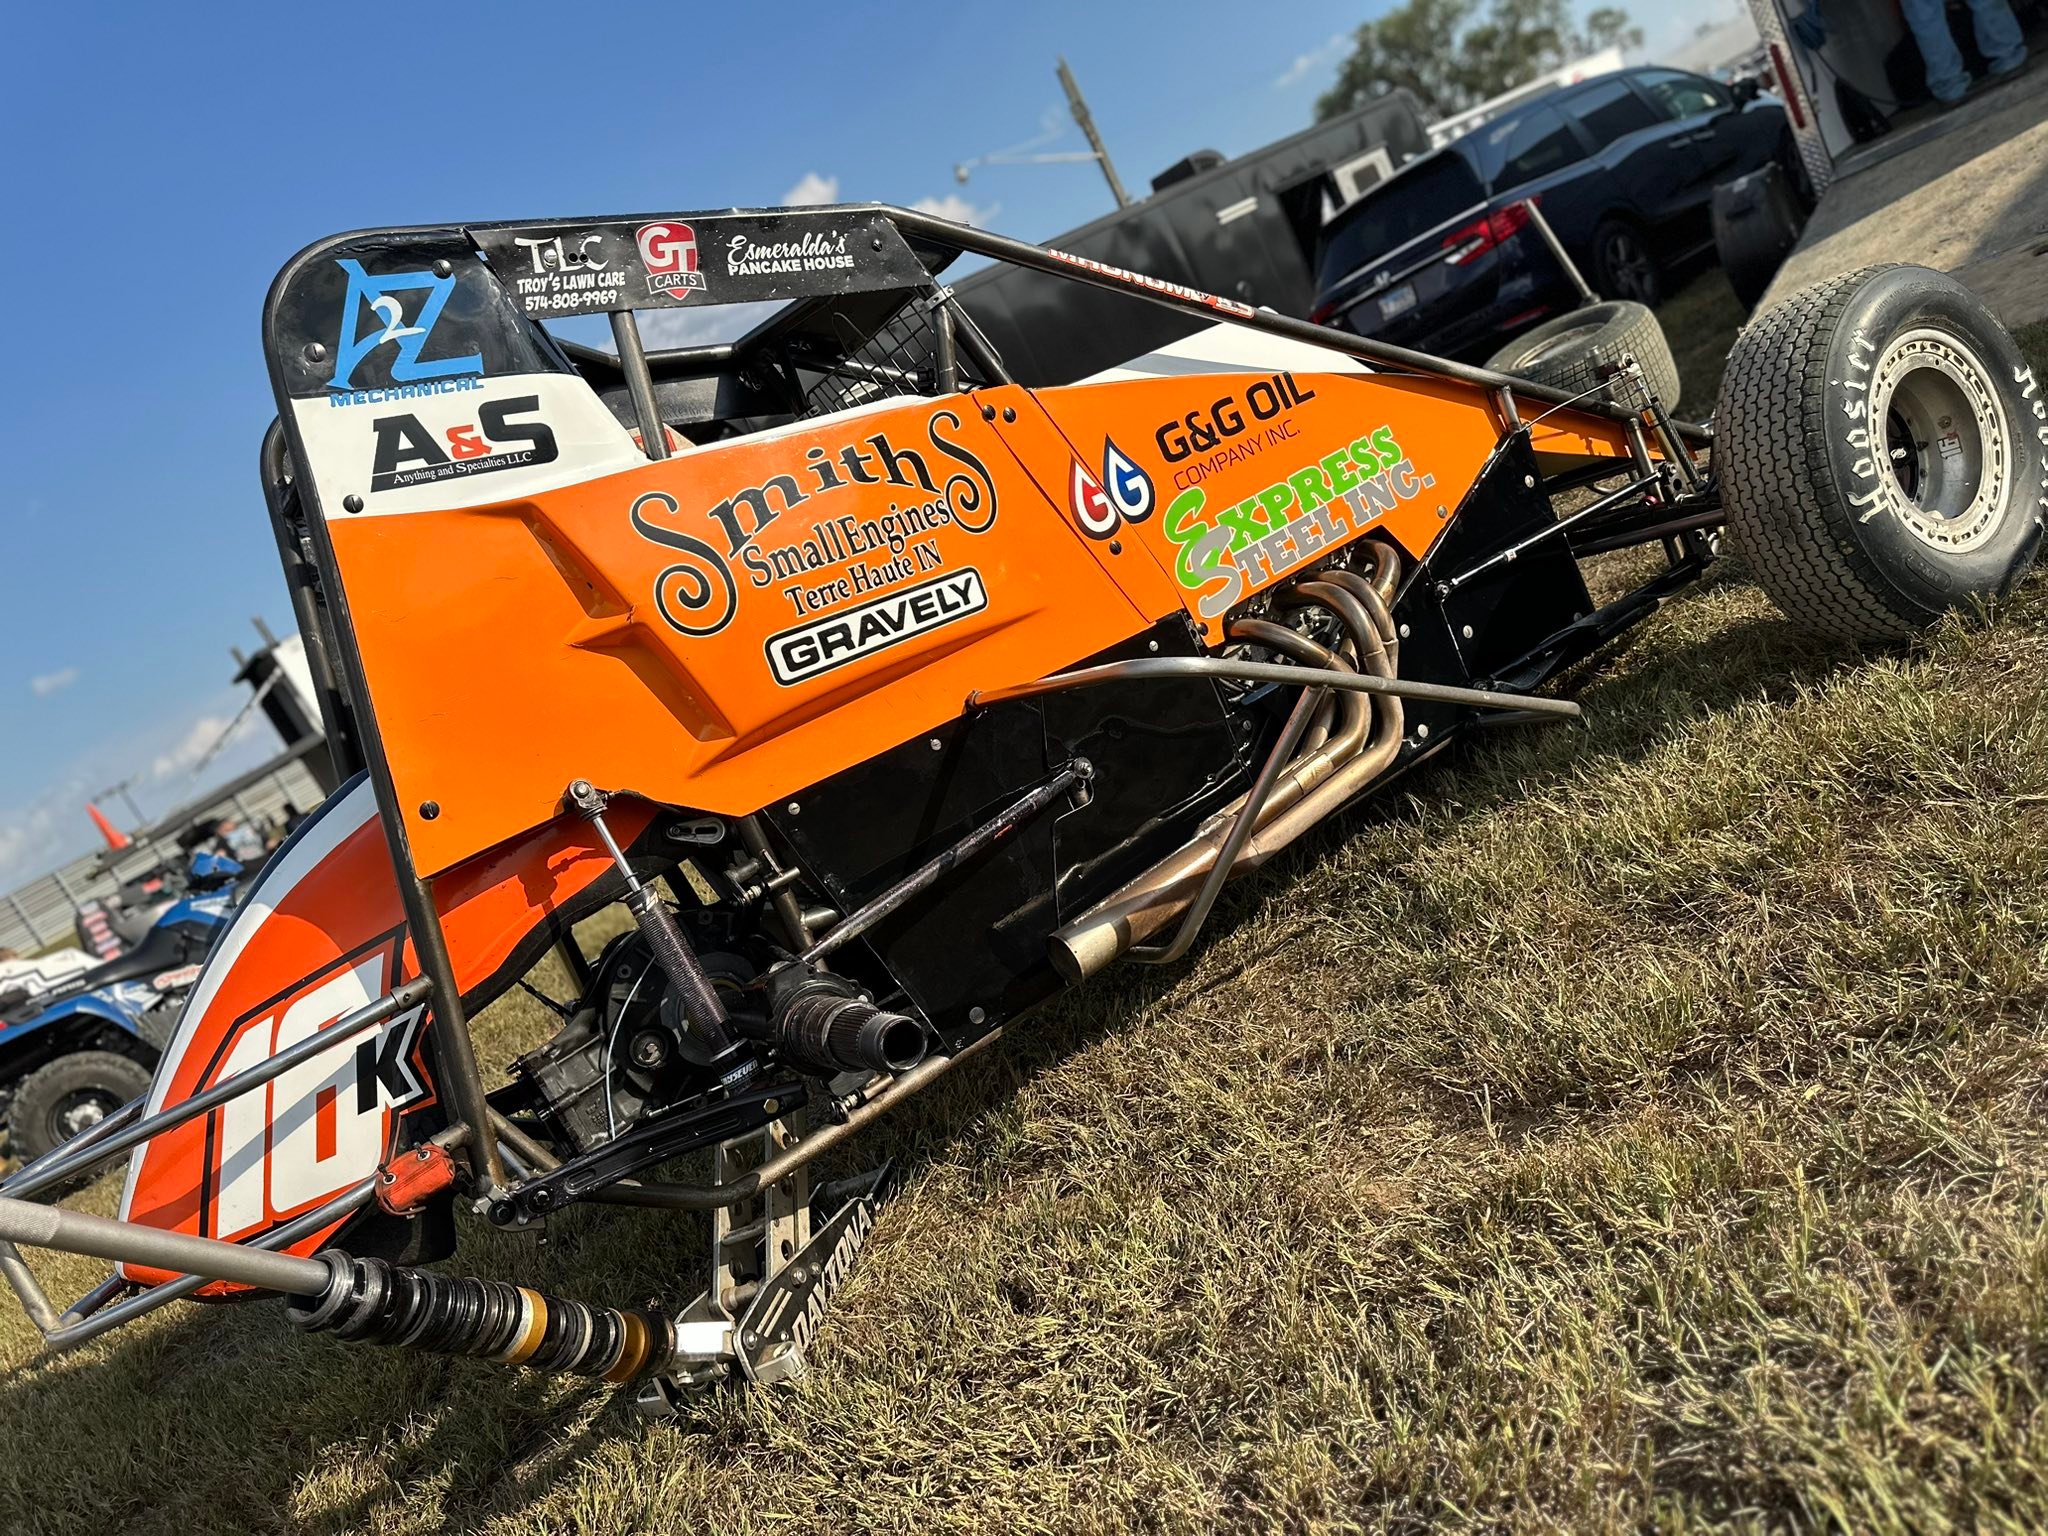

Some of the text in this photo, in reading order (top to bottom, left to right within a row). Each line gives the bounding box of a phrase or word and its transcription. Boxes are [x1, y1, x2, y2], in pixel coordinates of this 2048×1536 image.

[517, 271, 626, 294] TROY'S LAWN CARE
[639, 226, 699, 272] GT
[654, 273, 697, 288] CARTS
[726, 229, 847, 267] Esmeralda's
[728, 254, 855, 276] PANCAKE HOUSE
[524, 290, 618, 311] 574-808-9969
[330, 377, 484, 407] MECHANICAL
[1155, 371, 1315, 463] G&G OIL
[1829, 328, 1895, 524] Hoosier
[371, 395, 559, 475] A&S
[393, 451, 533, 485] Anything and Specialties LLC
[1173, 419, 1301, 491] COMPANY INC.
[1164, 425, 1404, 590] EXPRESS
[1190, 460, 1436, 618] STEEL INC.
[785, 540, 943, 616] Terre Haute IN
[781, 576, 973, 673] GRAVELY
[792, 1201, 873, 1353] DAYTONA
